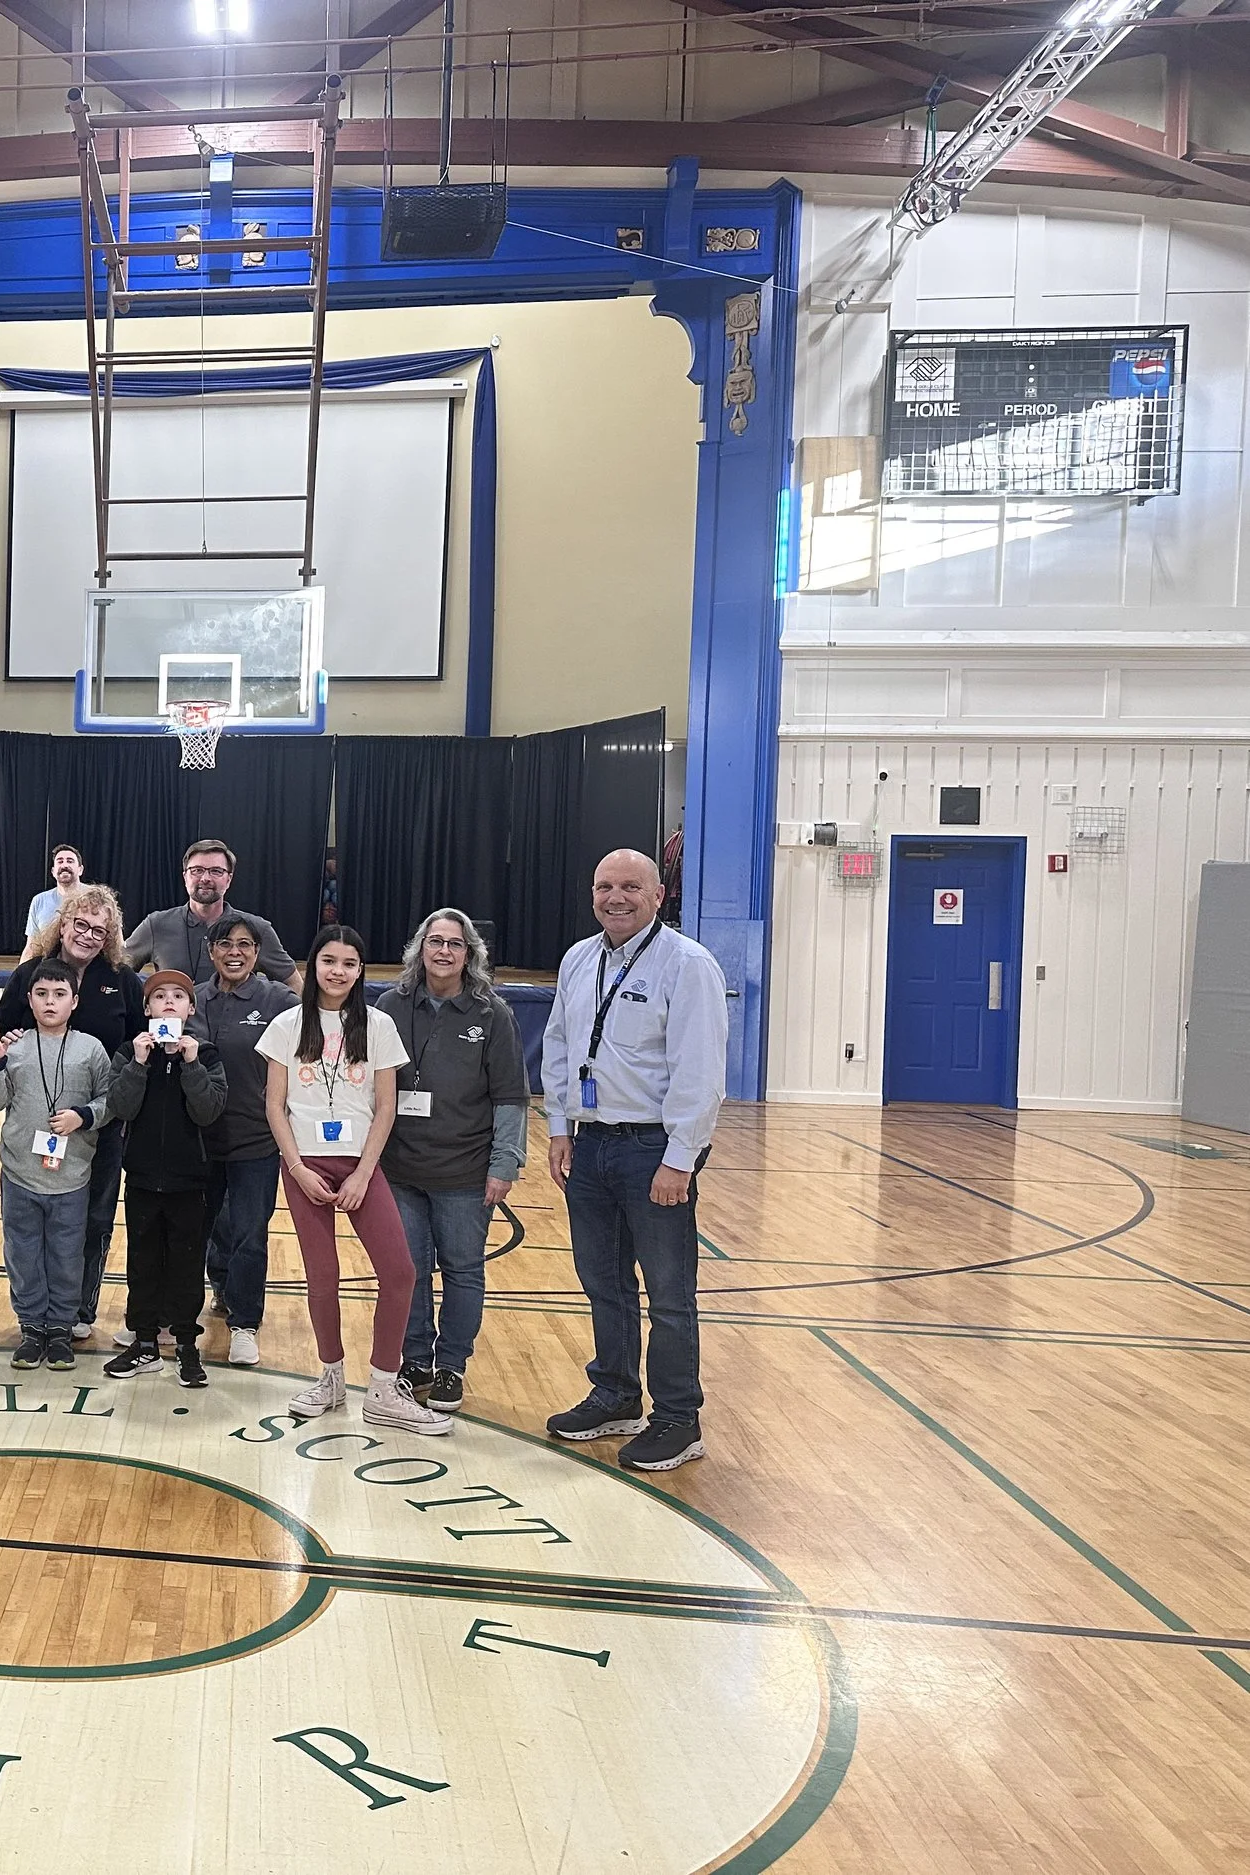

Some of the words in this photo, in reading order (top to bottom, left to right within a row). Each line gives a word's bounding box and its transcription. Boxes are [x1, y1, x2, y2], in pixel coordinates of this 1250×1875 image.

[1114, 348, 1168, 361] PEPSI
[906, 402, 961, 418] HOME
[1004, 403, 1058, 416] PERIOD
[229, 1415, 572, 1544] SCOTT
